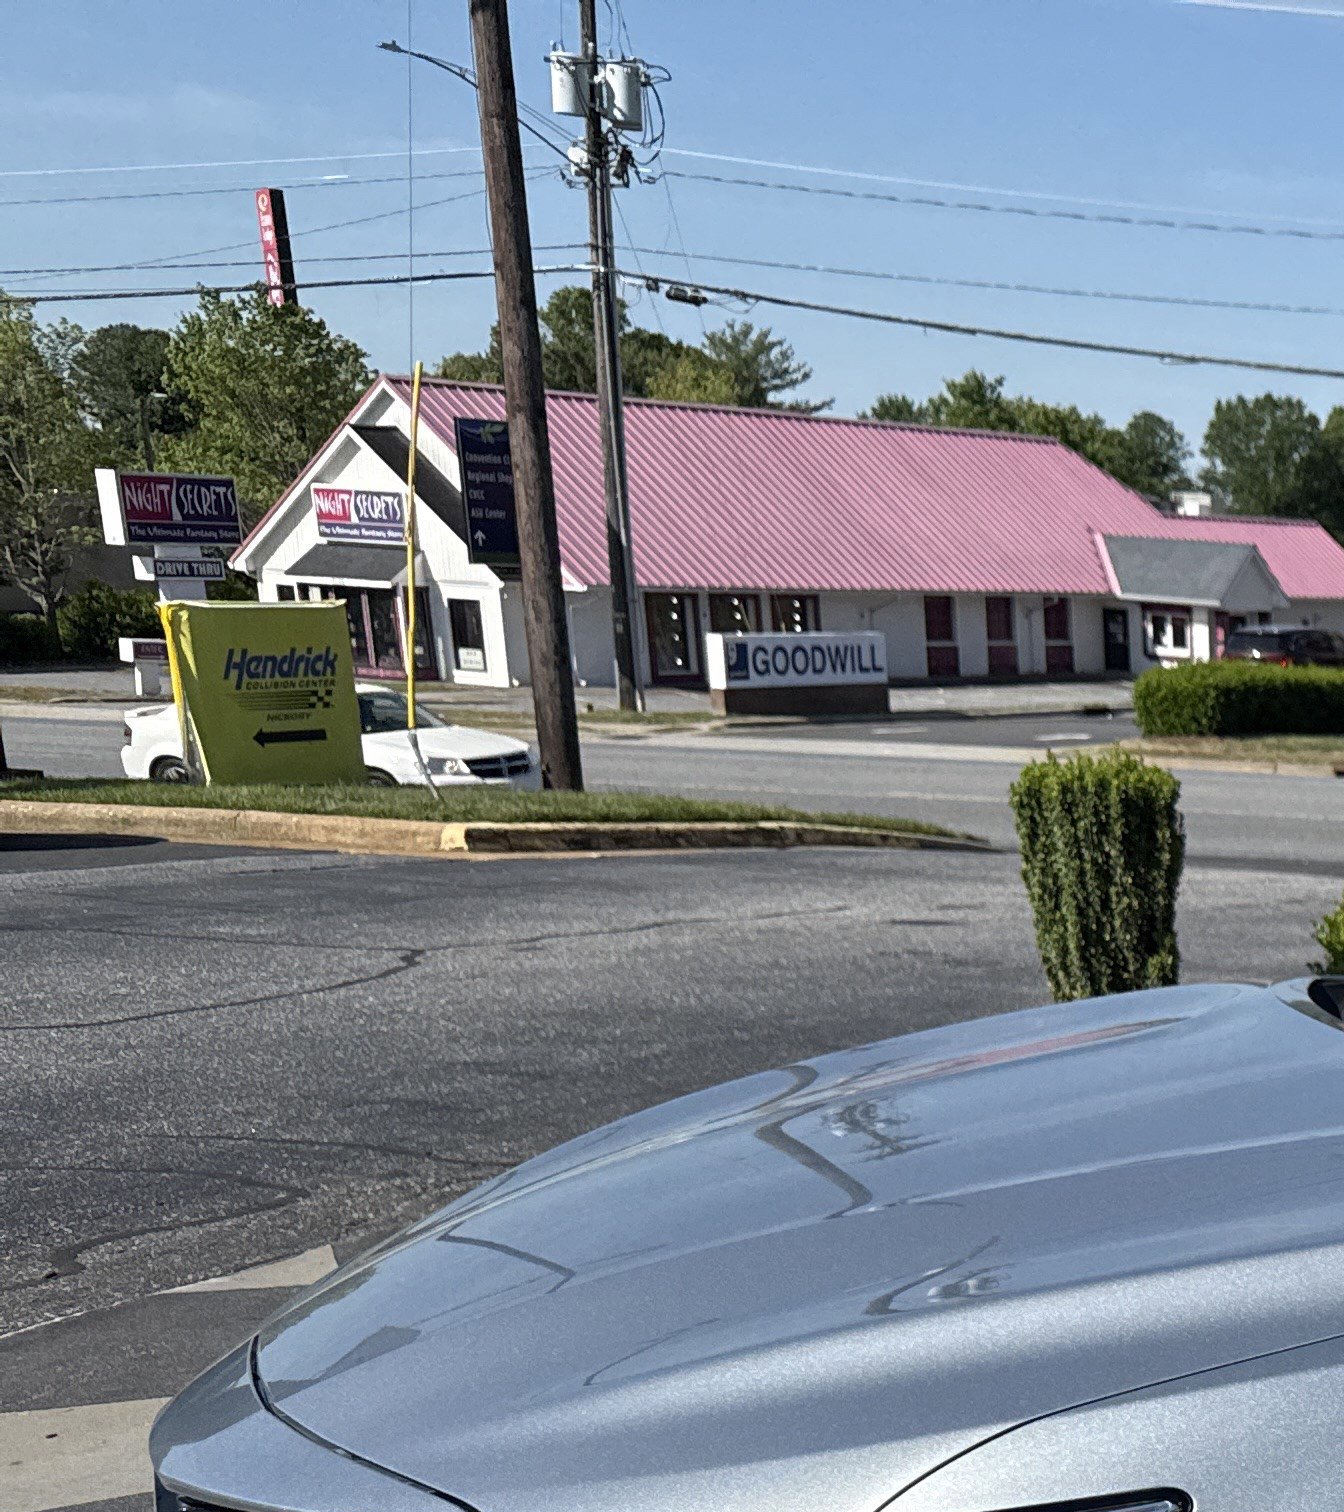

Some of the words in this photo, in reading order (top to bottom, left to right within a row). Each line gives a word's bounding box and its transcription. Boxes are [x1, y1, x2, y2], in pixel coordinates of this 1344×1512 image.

[179, 484, 236, 516] SECRETS
[356, 494, 400, 520] SECRETS
[156, 563, 190, 575] DRIVE
[191, 562, 221, 576] THRU
[223, 646, 338, 690] Hendrick
[752, 643, 884, 676] GOODWILL
[246, 682, 297, 690] COLLISION
[298, 679, 336, 688] CENTER
